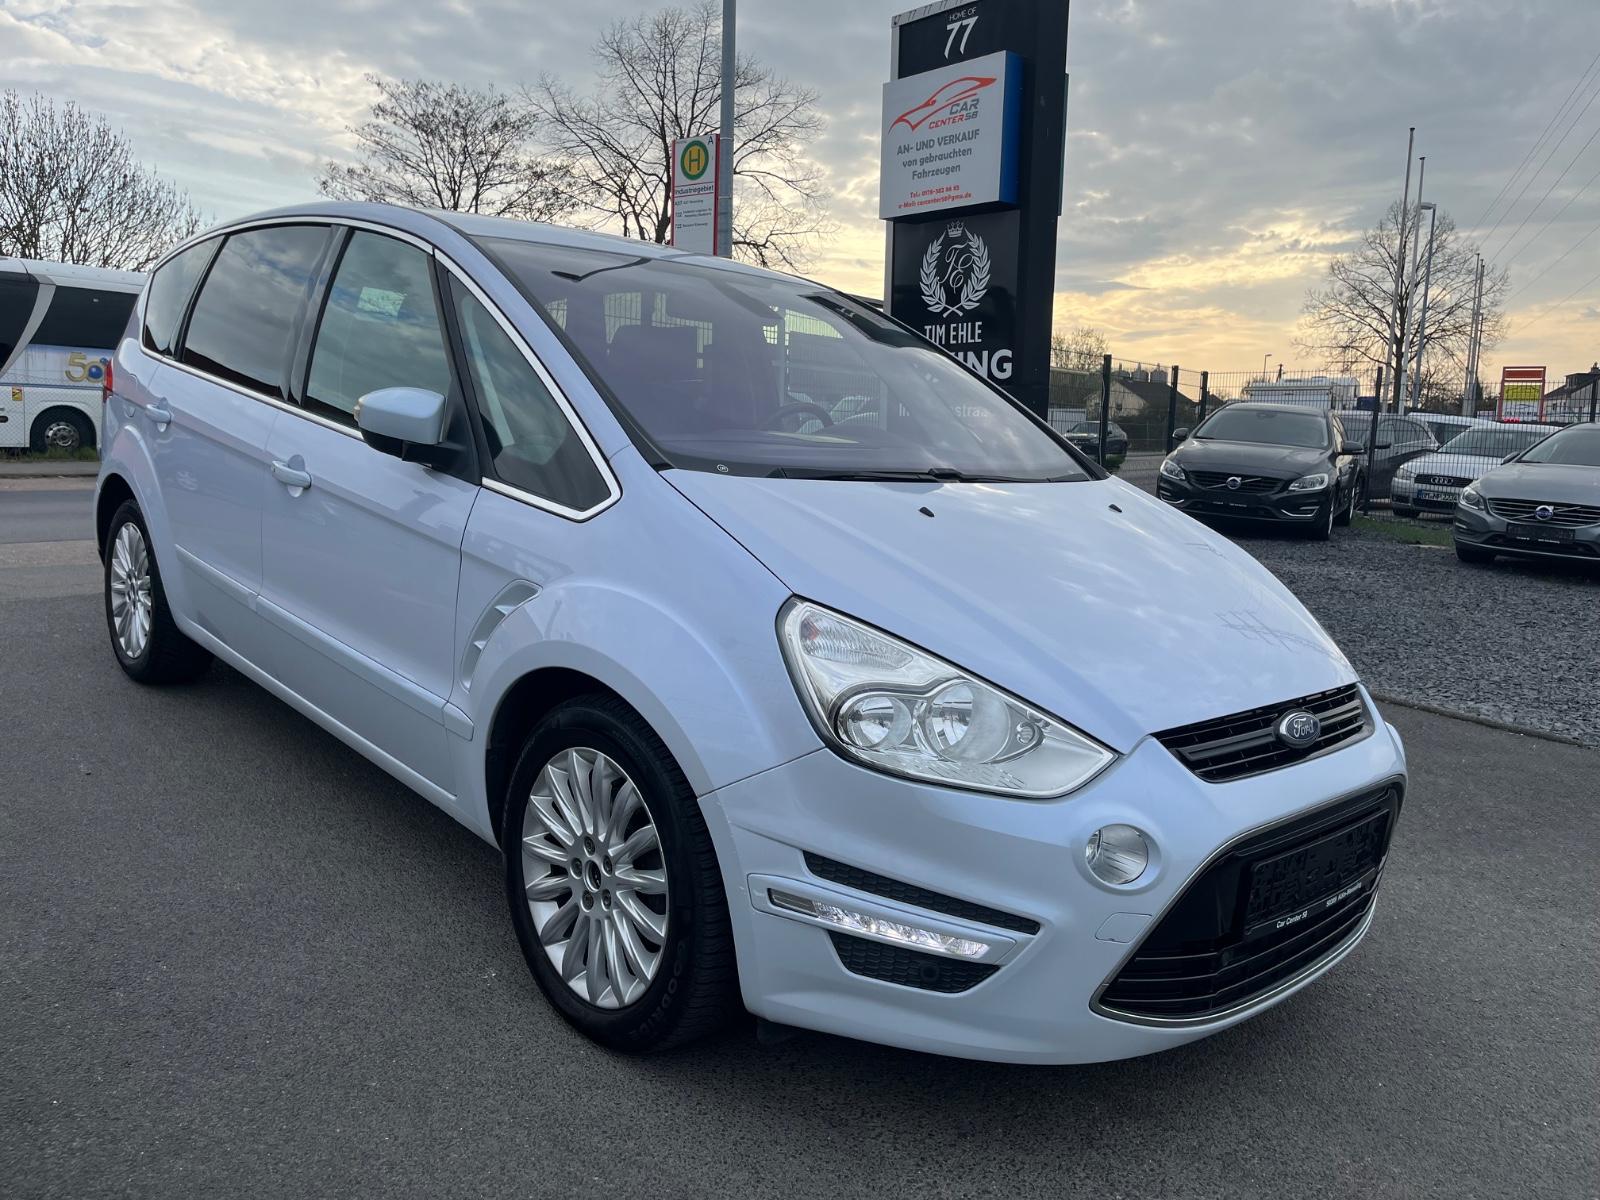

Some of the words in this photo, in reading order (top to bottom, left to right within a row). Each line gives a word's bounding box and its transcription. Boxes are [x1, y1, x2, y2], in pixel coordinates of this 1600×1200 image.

[949, 10, 966, 22] HOME
[968, 6, 977, 16] OF
[944, 15, 979, 60] 77
[950, 97, 980, 115] CAR
[707, 135, 714, 145] A
[896, 143, 914, 156] AN-
[915, 139, 935, 152] UND
[937, 129, 980, 148] VERKAUF
[902, 157, 918, 168] von
[919, 147, 972, 166] gebrauchten
[911, 164, 961, 181] Fahrzeugen
[924, 324, 946, 345] TIM
[949, 321, 983, 345] EHLE
[1293, 717, 1315, 738] Ford
[1276, 920, 1286, 929] Car
[1286, 914, 1302, 926] Center
